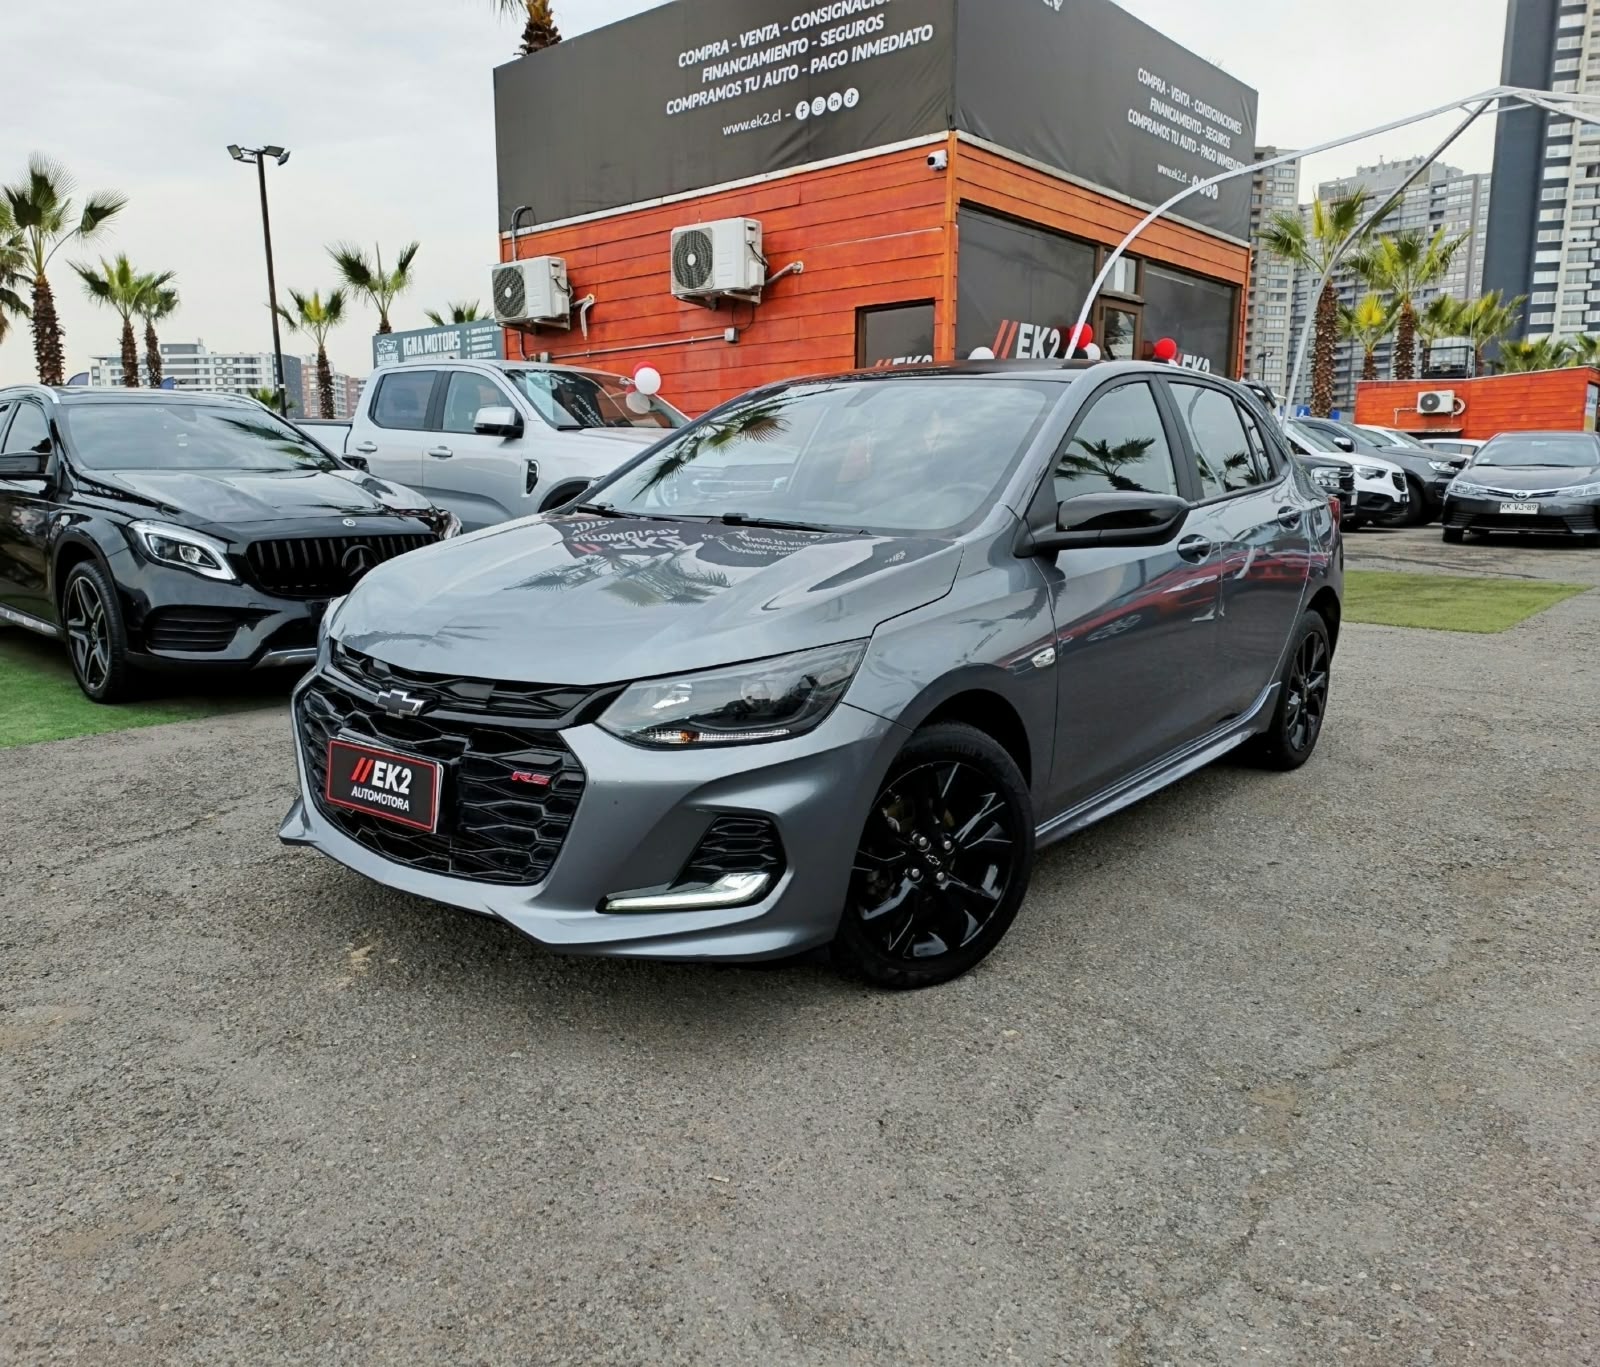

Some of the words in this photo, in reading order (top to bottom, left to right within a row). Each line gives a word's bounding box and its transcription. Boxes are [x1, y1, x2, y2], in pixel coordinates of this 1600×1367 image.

[679, 39, 729, 67] COMPRA
[739, 23, 780, 49] VENTA
[702, 37, 809, 83] FINANCIAMIENTO
[820, 13, 885, 47] SEGUROS
[666, 80, 742, 115] COMPRAMOS
[744, 75, 760, 93] TU
[762, 64, 799, 88] AUTO
[810, 49, 849, 74] PAGO
[851, 24, 934, 62] INMEDIATO
[722, 109, 782, 136] www.ek2.cl
[1138, 67, 1166, 95] COMPRA
[1171, 85, 1190, 108] VENTA
[1194, 99, 1243, 135] CONSIGNACIONES
[1150, 97, 1202, 135] FINANCIAMIENTO
[1206, 126, 1231, 149] SEGUROS
[1128, 108, 1170, 141] COMPRAMOS
[1171, 129, 1180, 145] TU
[1180, 134, 1197, 154] AUTO
[1201, 144, 1217, 162] PAGO
[424, 330, 461, 354] MOTORS
[351, 785, 410, 812] AUTOMOTORA
[511, 771, 551, 785] RS
